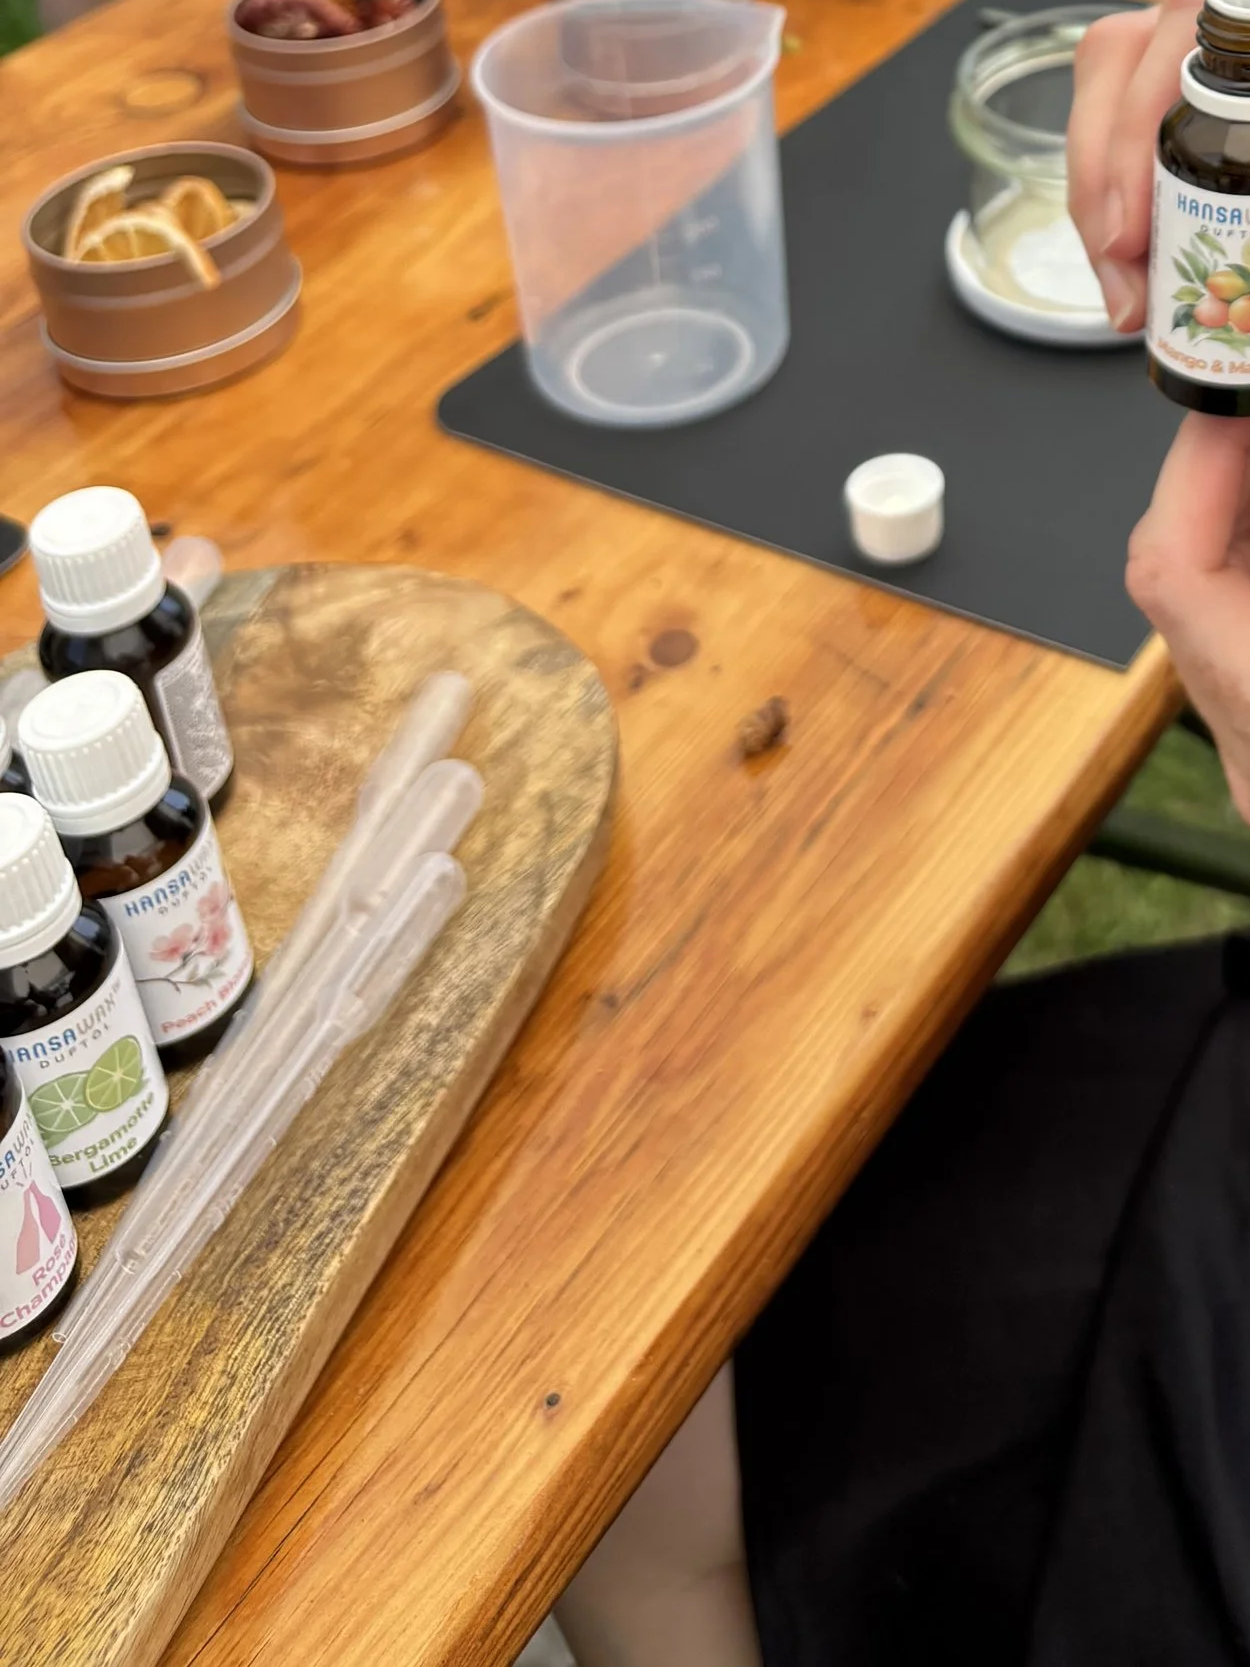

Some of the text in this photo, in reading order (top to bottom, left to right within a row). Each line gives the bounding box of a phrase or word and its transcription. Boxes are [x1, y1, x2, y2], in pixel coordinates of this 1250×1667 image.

[1211, 359, 1223, 374] &
[162, 1000, 217, 1033] Peach
[89, 1137, 137, 1173] Lime
